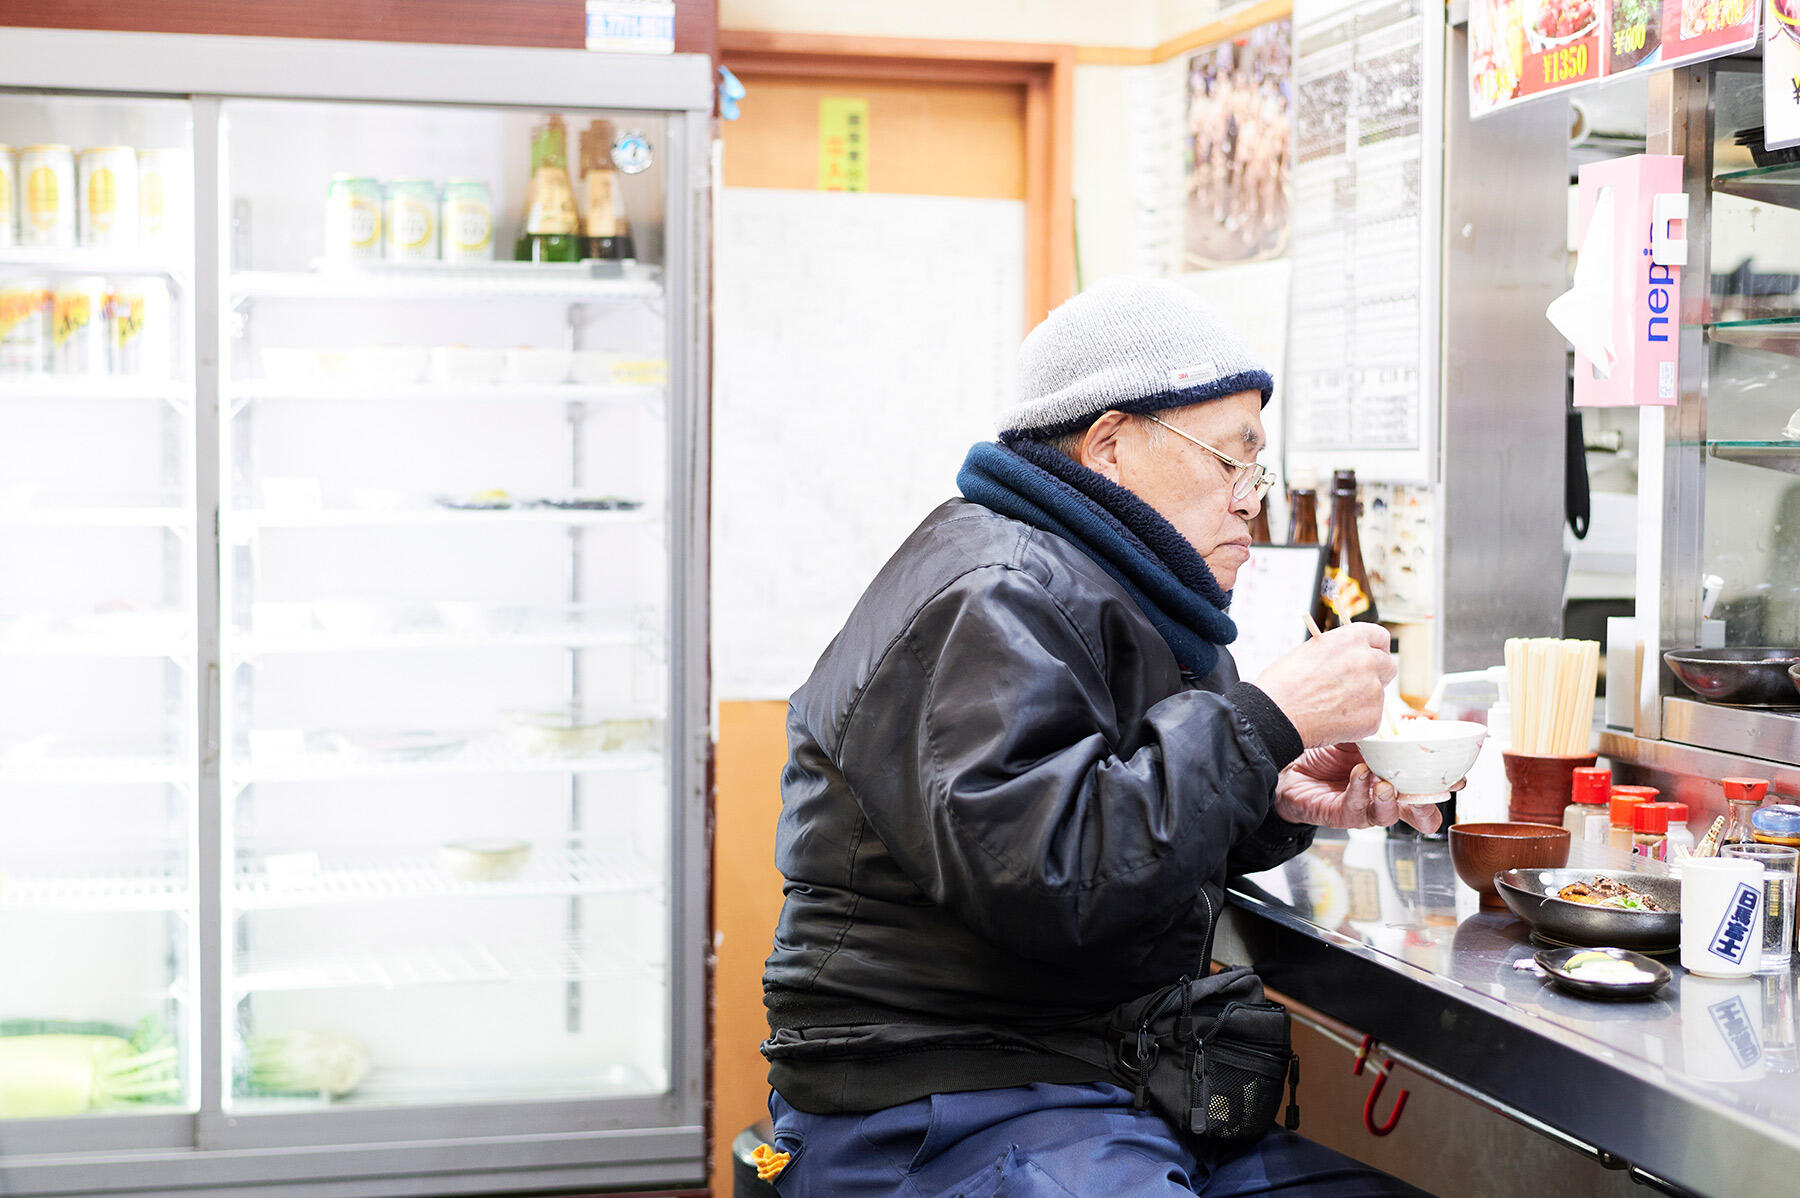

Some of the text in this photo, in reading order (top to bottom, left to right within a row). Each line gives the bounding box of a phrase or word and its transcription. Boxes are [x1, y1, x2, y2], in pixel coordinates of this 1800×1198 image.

[1612, 24, 1647, 56] ¥800
[1543, 43, 1588, 84] ¥1350
[1643, 222, 1674, 342] nep
